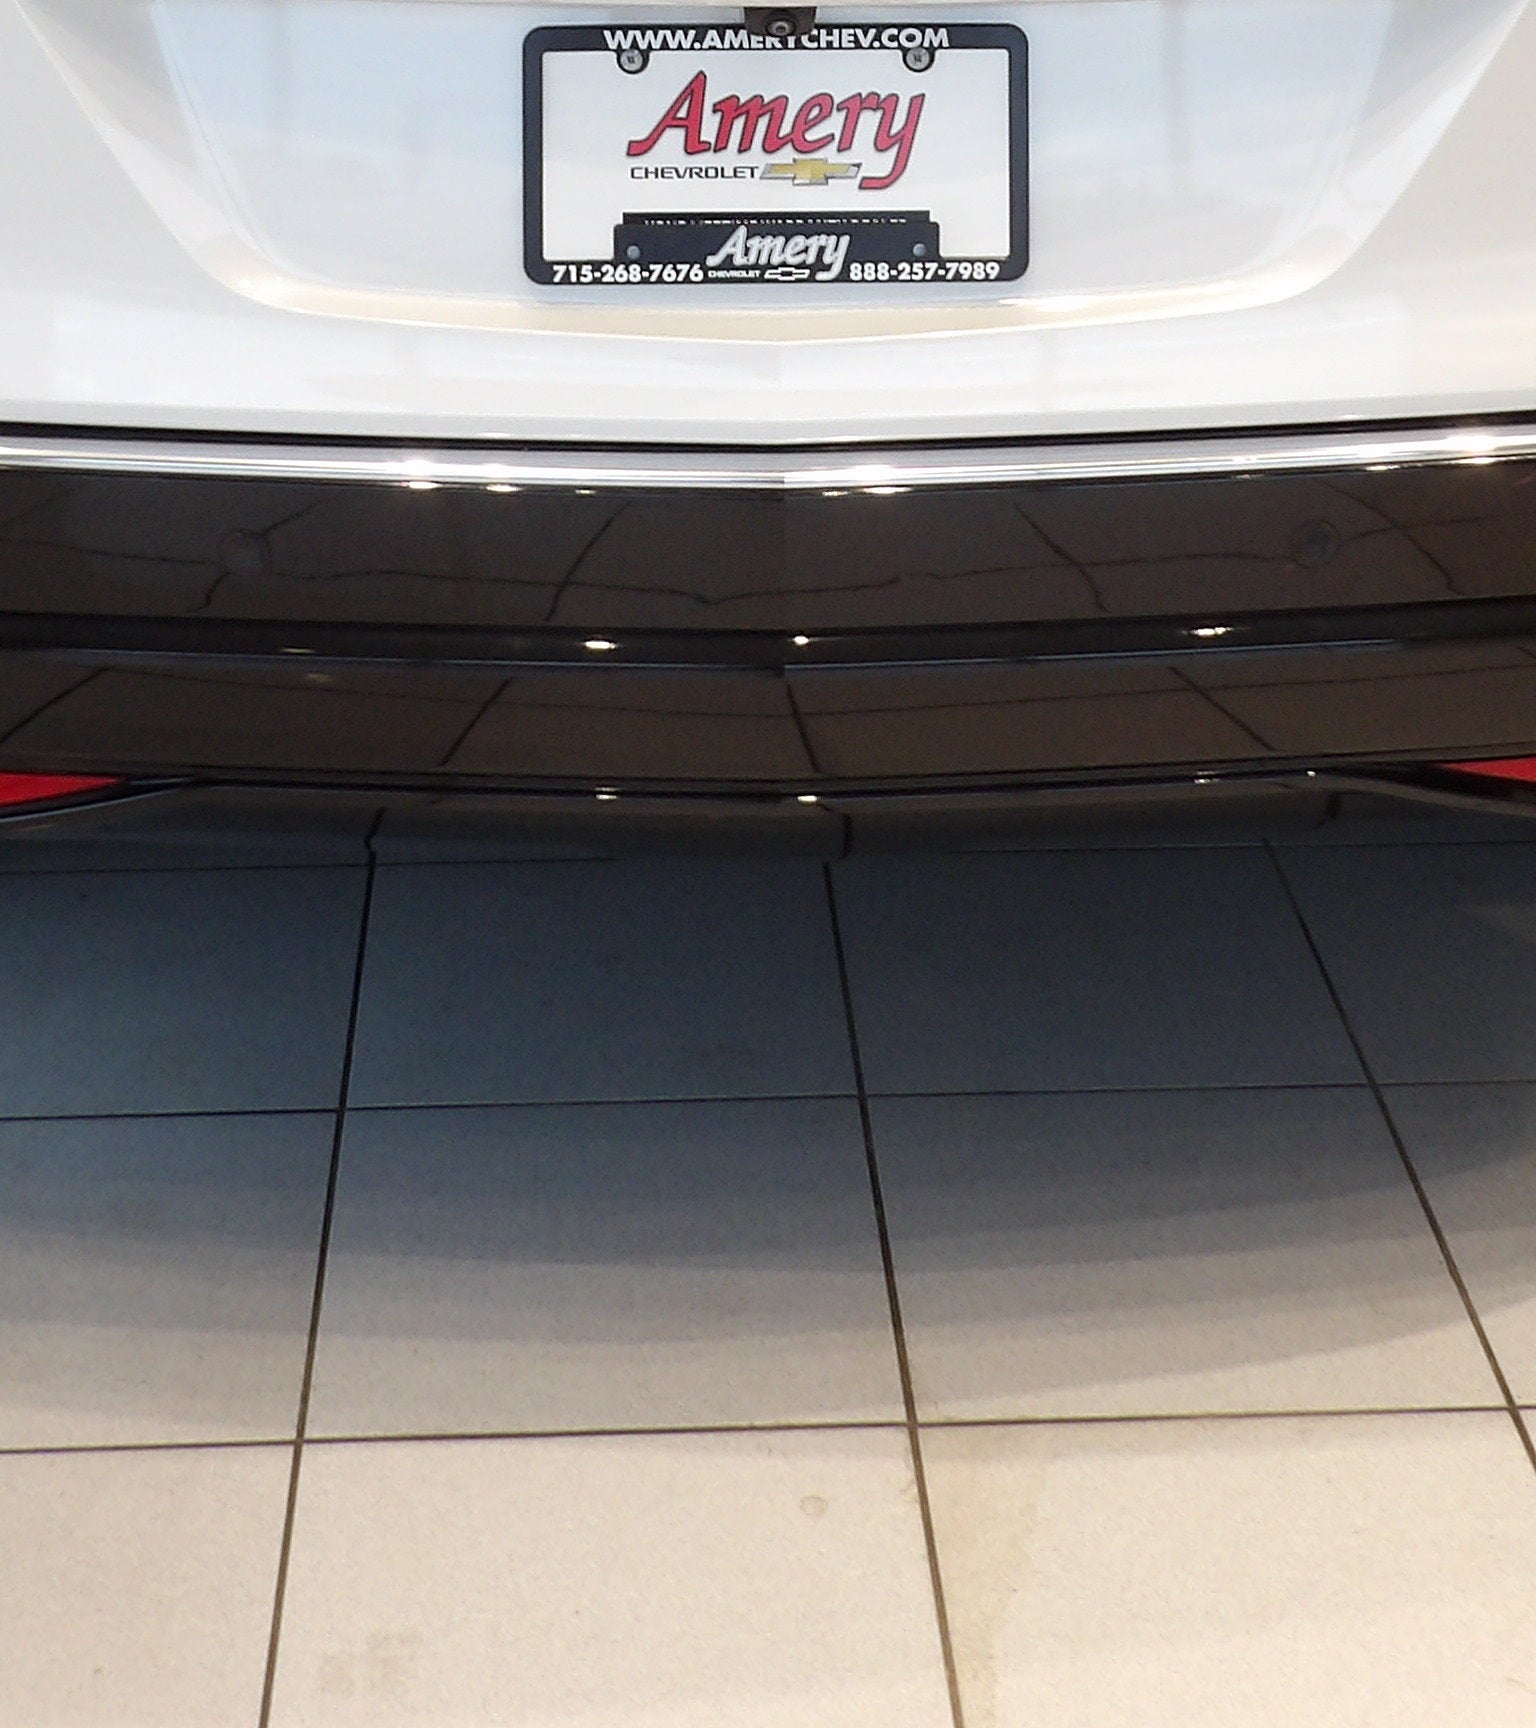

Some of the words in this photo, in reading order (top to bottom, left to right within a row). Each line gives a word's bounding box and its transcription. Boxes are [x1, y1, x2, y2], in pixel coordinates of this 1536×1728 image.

[625, 69, 926, 191] Amery
[630, 165, 761, 180] CHEVROLET
[552, 263, 705, 284] 715-268-7676
[707, 269, 762, 279] CHEVROLET
[849, 261, 1001, 281] 888-257-7989
[705, 224, 851, 281] Amery
